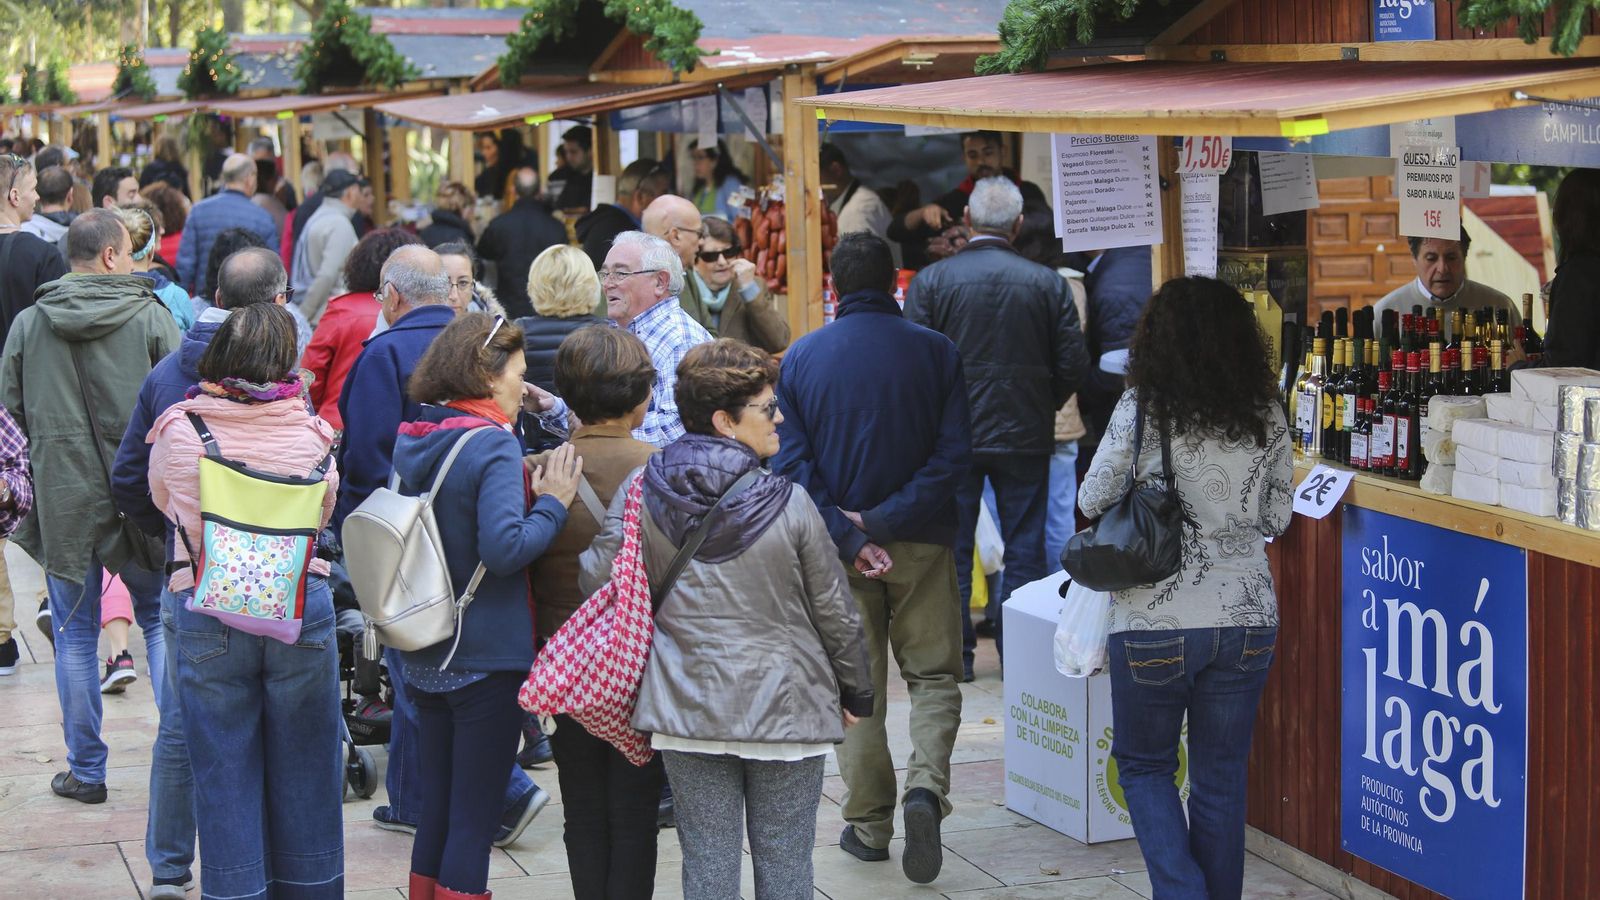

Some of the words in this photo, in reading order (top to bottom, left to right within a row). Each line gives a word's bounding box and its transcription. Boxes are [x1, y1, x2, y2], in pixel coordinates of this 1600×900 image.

[1071, 136, 1103, 145] Precios
[1185, 136, 1229, 172] 1,50€
[1062, 160, 1084, 168] Vegasol
[1063, 169, 1090, 177] Vermouth
[1403, 152, 1430, 165] QUESO
[1407, 172, 1439, 182] PREMIADOS
[1441, 174, 1453, 183] POR
[1407, 189, 1427, 198] SABOR
[1428, 190, 1433, 198] A
[1433, 188, 1455, 200] MÁLAGA
[1424, 210, 1441, 228] 15€
[1300, 474, 1337, 505] 2€
[1361, 535, 1424, 590] sabor
[1362, 588, 1379, 631] a
[1022, 692, 1067, 721] COLABORA
[1011, 705, 1027, 723] CON
[1029, 712, 1040, 728] LA
[1042, 717, 1079, 744] LIMPIEZA
[1361, 647, 1501, 823] laga
[1017, 724, 1027, 741] DE
[1029, 730, 1039, 746] TU
[1042, 735, 1073, 759] CIUDAD
[1361, 774, 1403, 805] PRODUCTOS
[1361, 795, 1408, 827] AUTÓCTONOS
[1361, 814, 1370, 832] DE
[1372, 820, 1381, 837] LA
[1383, 824, 1423, 855] PROVINCIA
